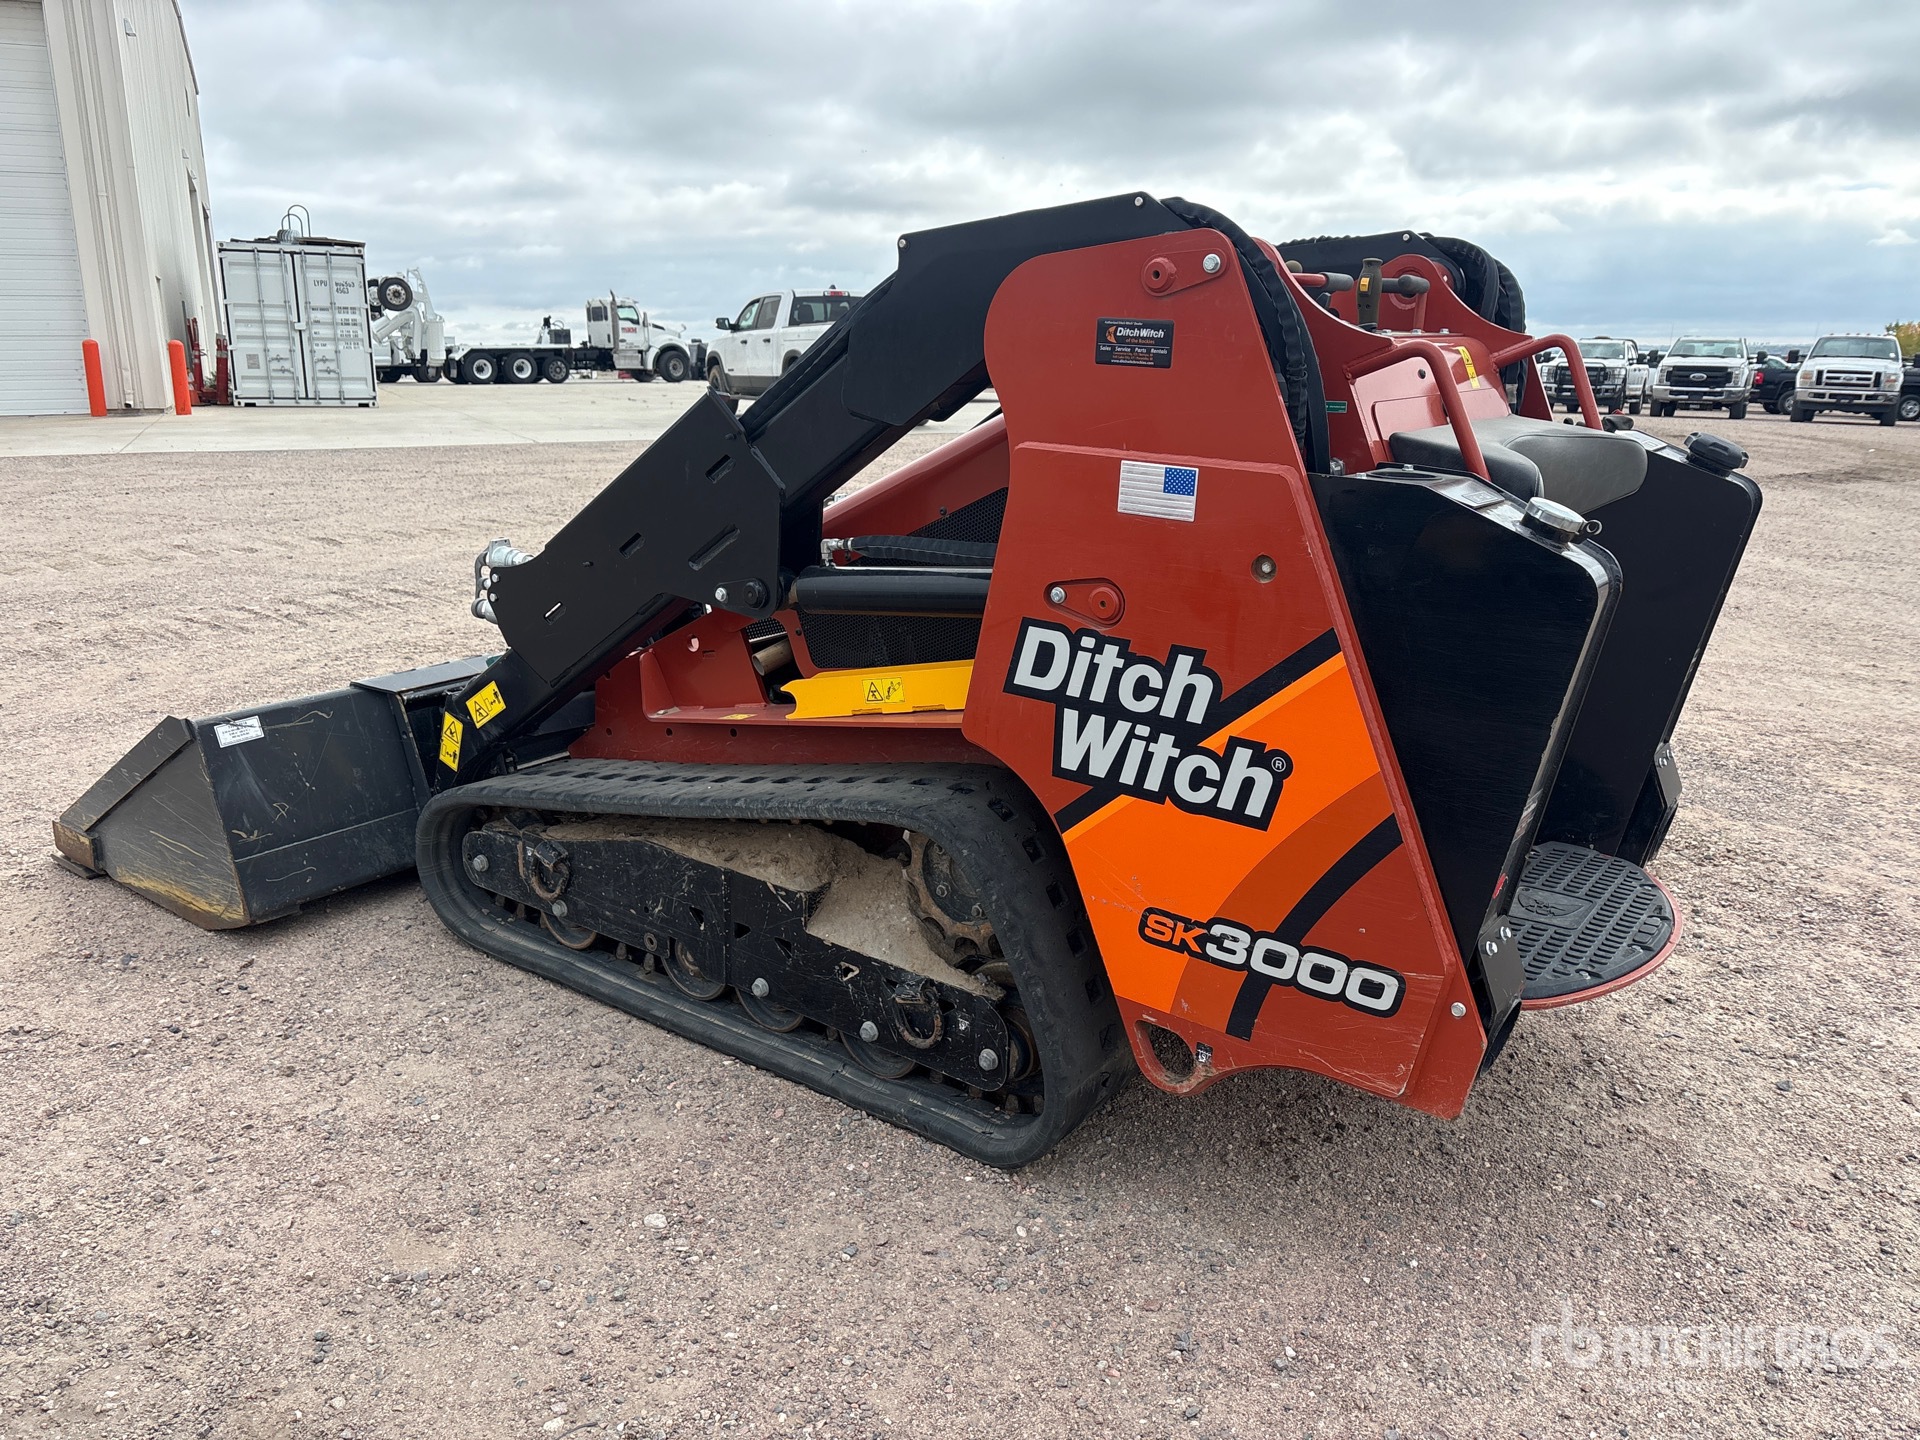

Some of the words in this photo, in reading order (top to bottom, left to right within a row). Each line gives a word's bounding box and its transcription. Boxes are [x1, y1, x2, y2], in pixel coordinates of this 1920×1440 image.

[313, 279, 328, 287] LYPU
[335, 287, 350, 295] 45G3
[1013, 625, 1214, 724] Ditch
[1143, 912, 1400, 1012] SK3000
